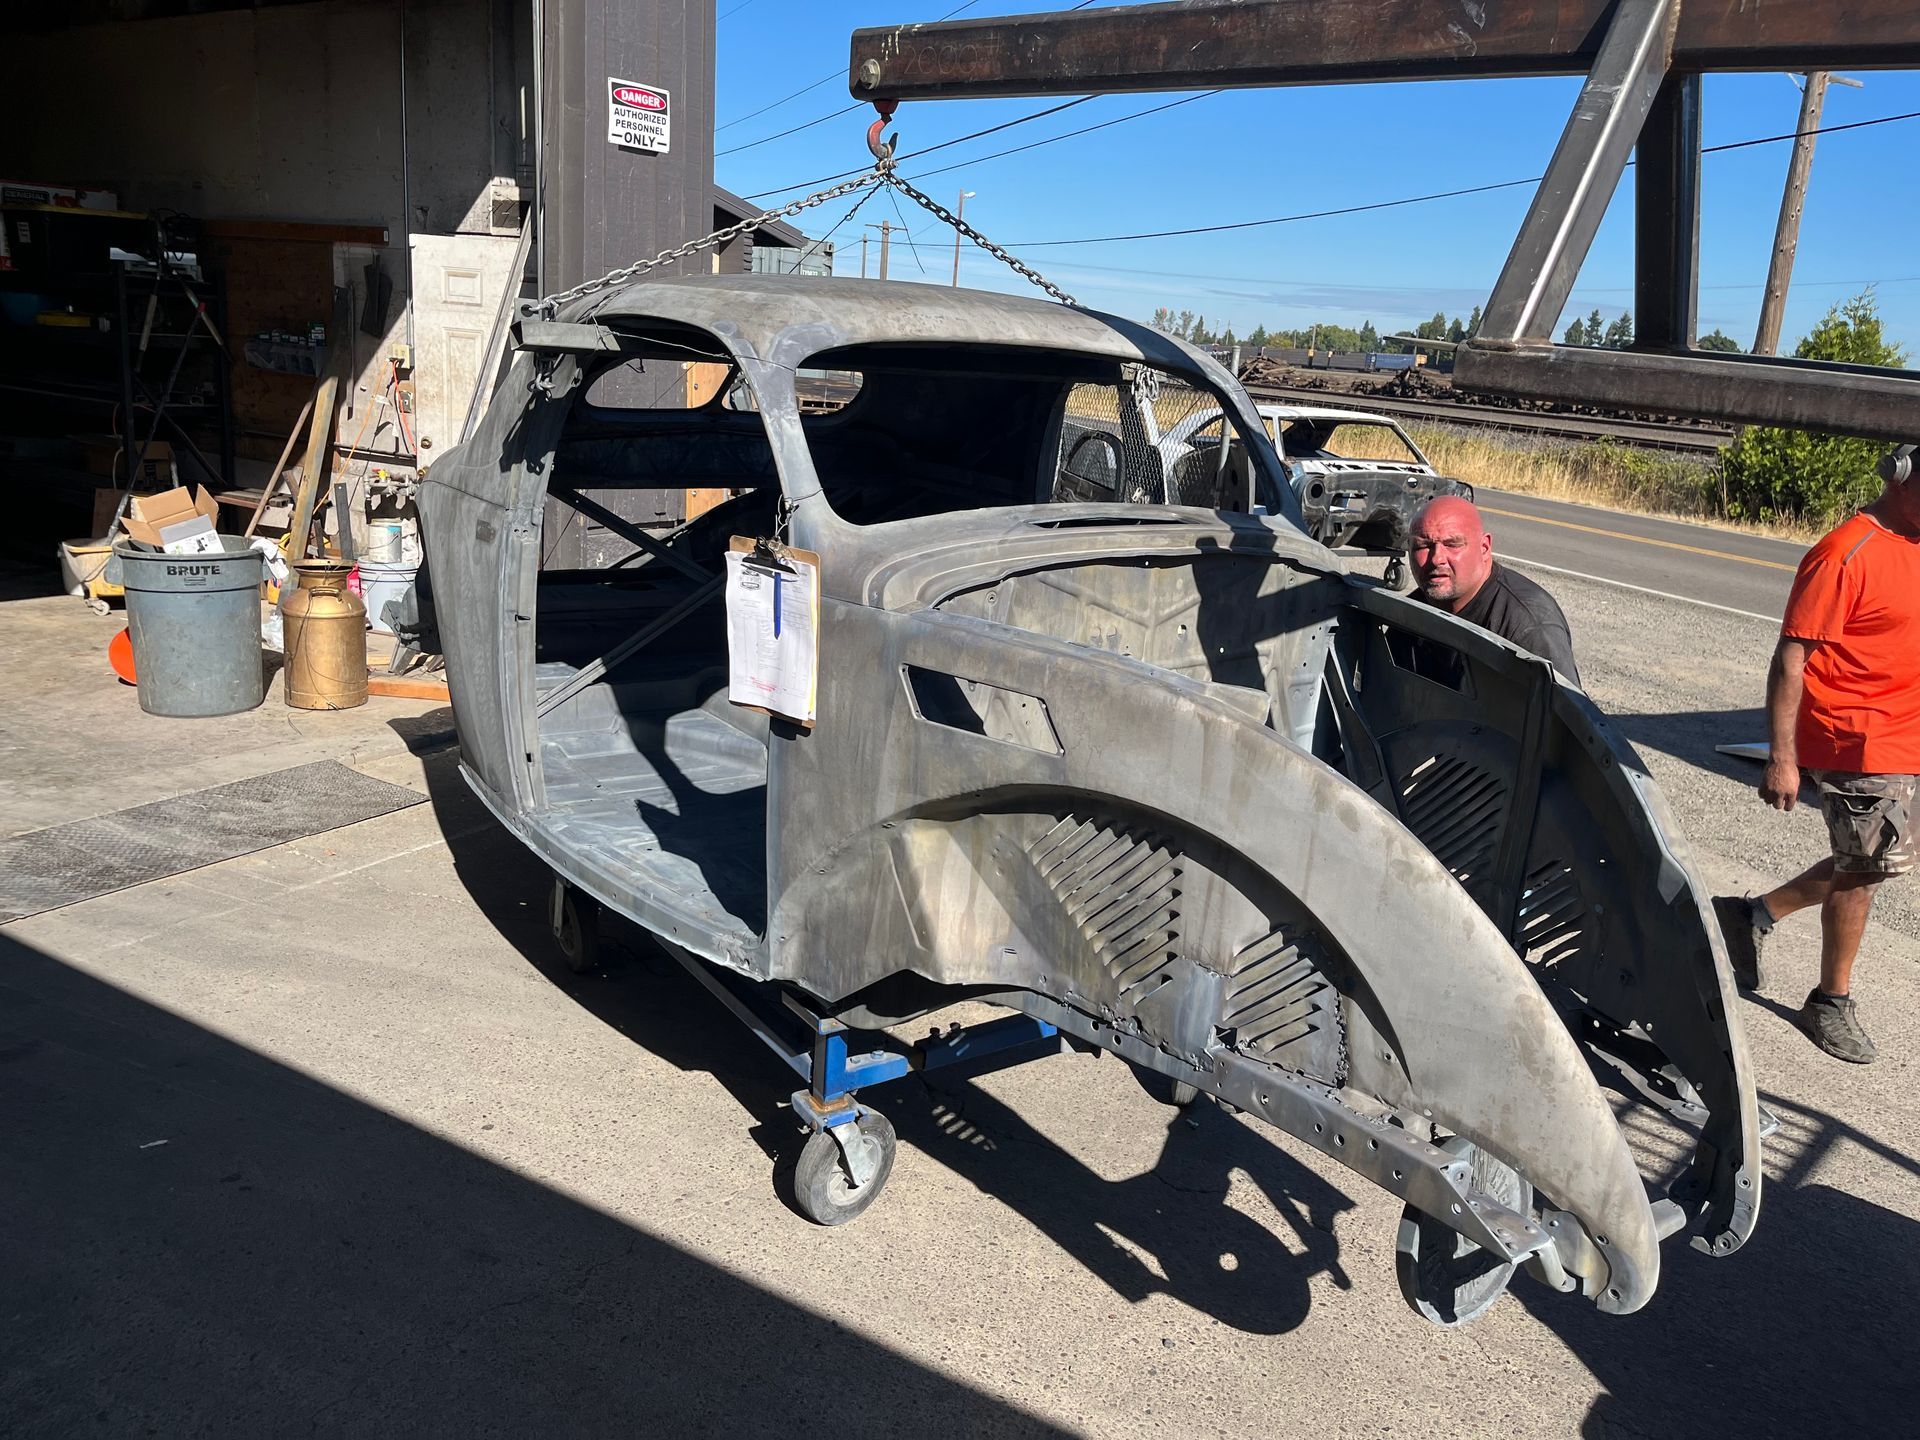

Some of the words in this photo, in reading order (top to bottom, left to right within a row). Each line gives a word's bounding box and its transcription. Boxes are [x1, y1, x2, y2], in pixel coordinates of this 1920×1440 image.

[621, 90, 660, 108] DANGER
[614, 107, 666, 125] AUTHORIZED
[616, 119, 664, 136] PERSONNEL
[624, 132, 655, 147] ONLY
[167, 565, 221, 576] BRUTE
